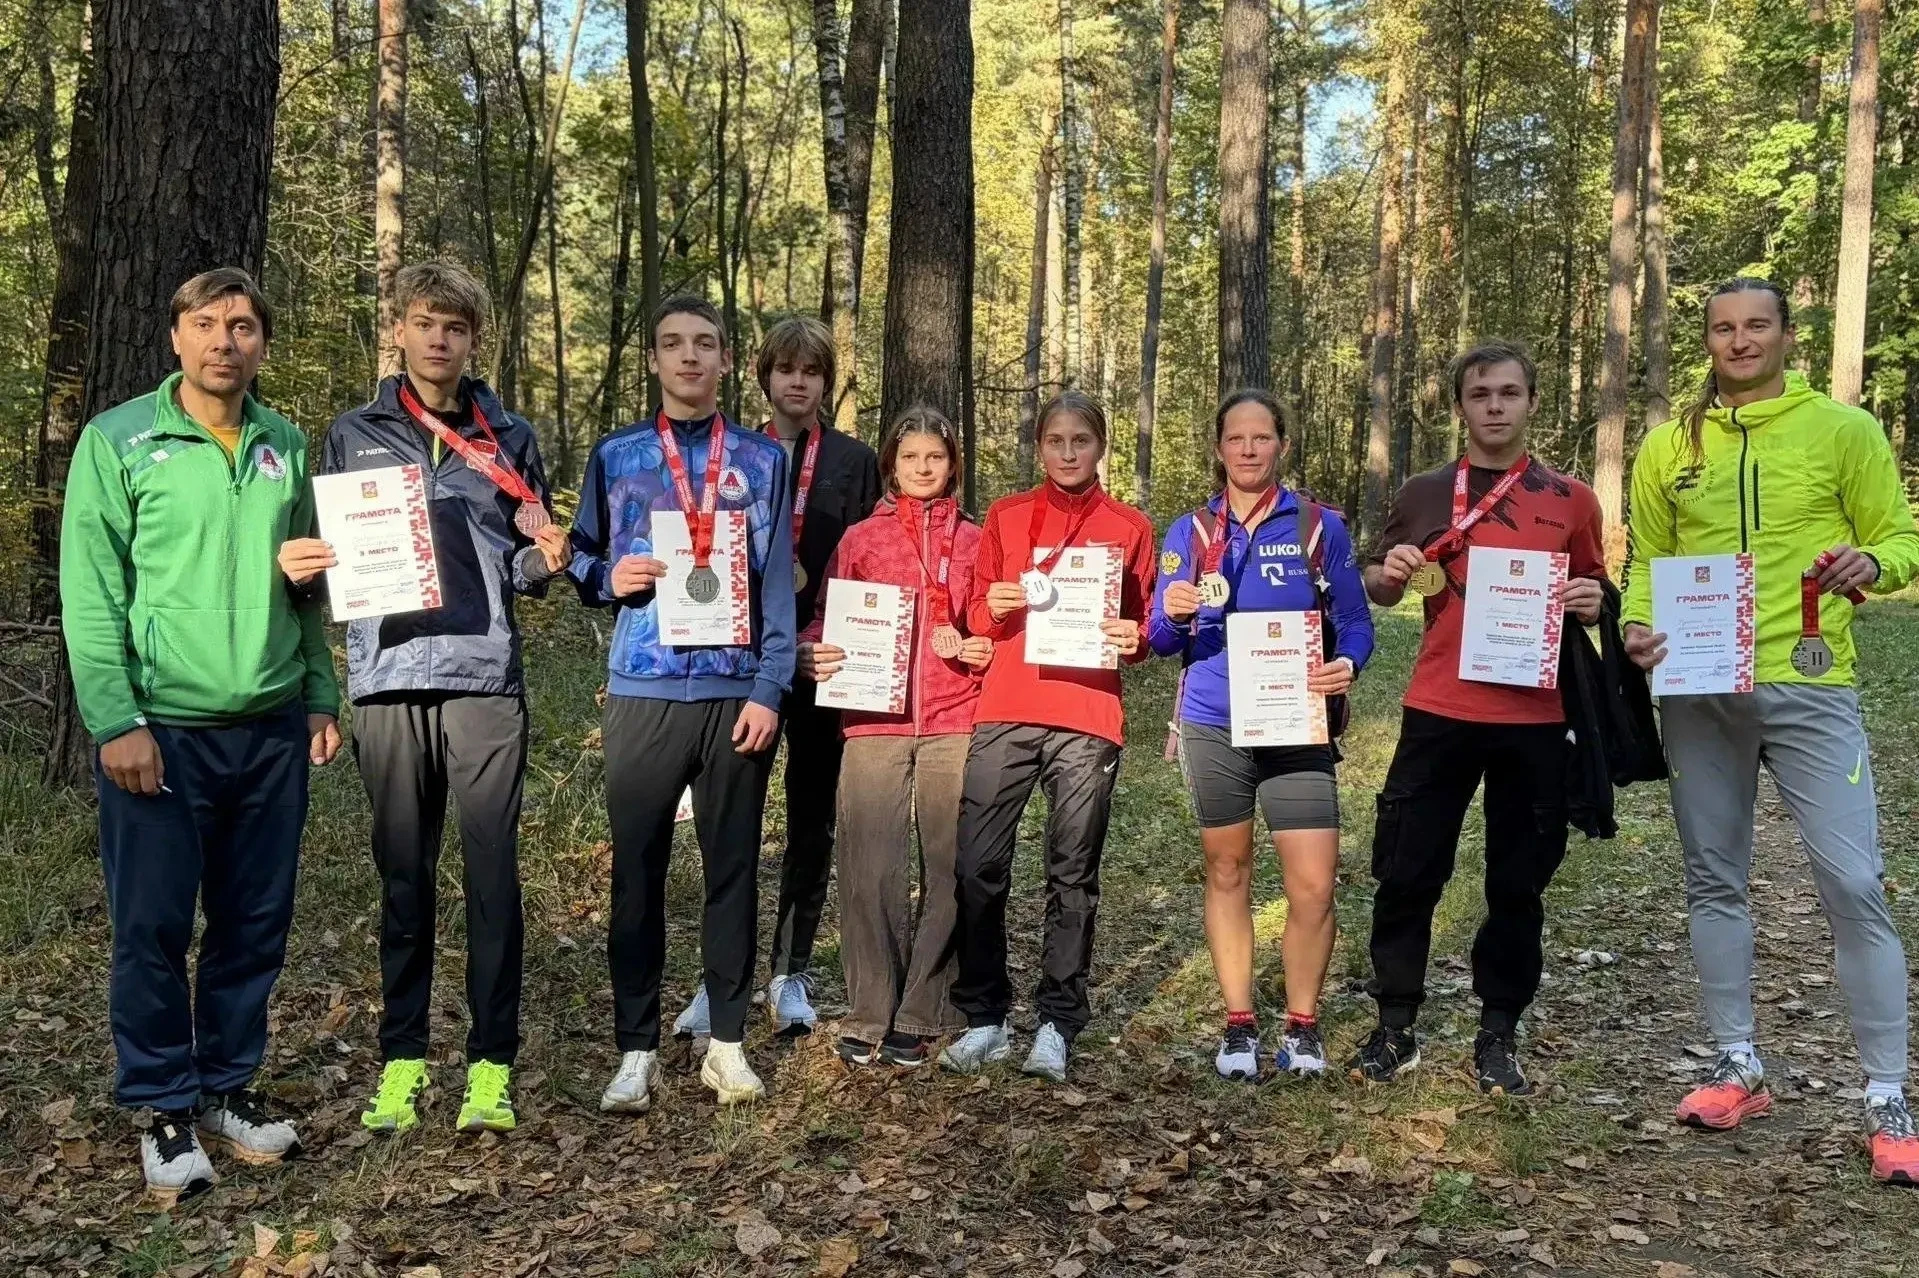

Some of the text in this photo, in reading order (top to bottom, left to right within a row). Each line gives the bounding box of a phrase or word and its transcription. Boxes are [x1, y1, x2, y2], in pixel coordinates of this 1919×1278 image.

[345, 507, 402, 522] ГРАМОТА
[368, 546, 399, 556] МЕСТО
[675, 548, 725, 556] ГРАТА
[1260, 543, 1302, 556] LUKOI
[702, 579, 712, 593] II
[1212, 584, 1223, 597] II
[1489, 585, 1541, 597] ГРАМОТА
[1676, 593, 1730, 603] ГРАМОТА
[845, 616, 892, 627] ГРАМОТА
[1502, 622, 1529, 630] МЕСТО
[1693, 630, 1722, 638] МЕСТО
[1250, 648, 1301, 657] ГРАМОТА
[1811, 651, 1823, 666] II
